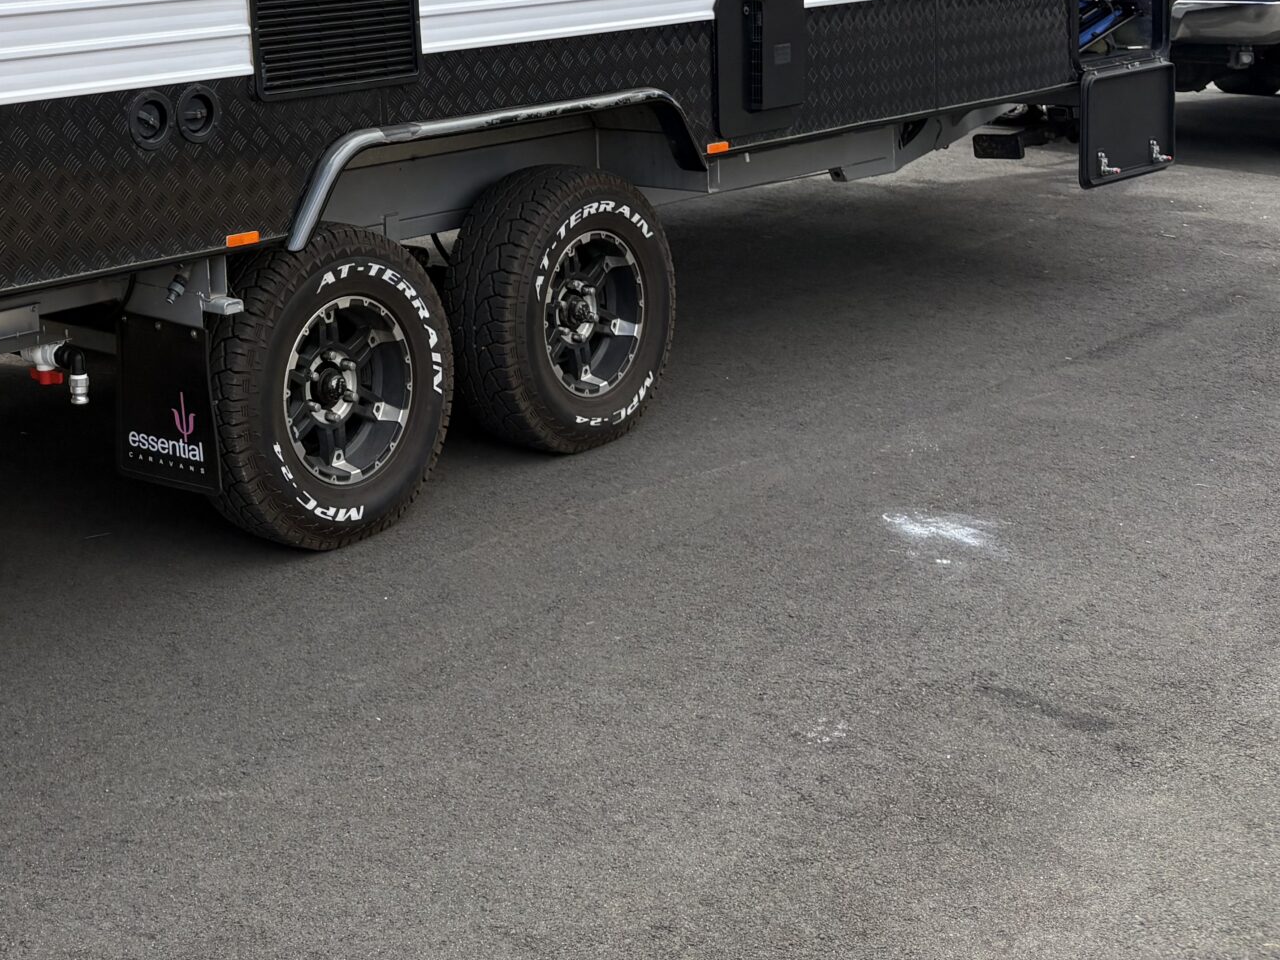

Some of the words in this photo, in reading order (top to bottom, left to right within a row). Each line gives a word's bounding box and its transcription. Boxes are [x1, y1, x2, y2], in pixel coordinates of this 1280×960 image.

[535, 200, 655, 303] AT-TERRAIN
[316, 262, 443, 395] AT-TERRAIN
[128, 431, 204, 462] essential
[128, 451, 205, 475] CARAVANS
